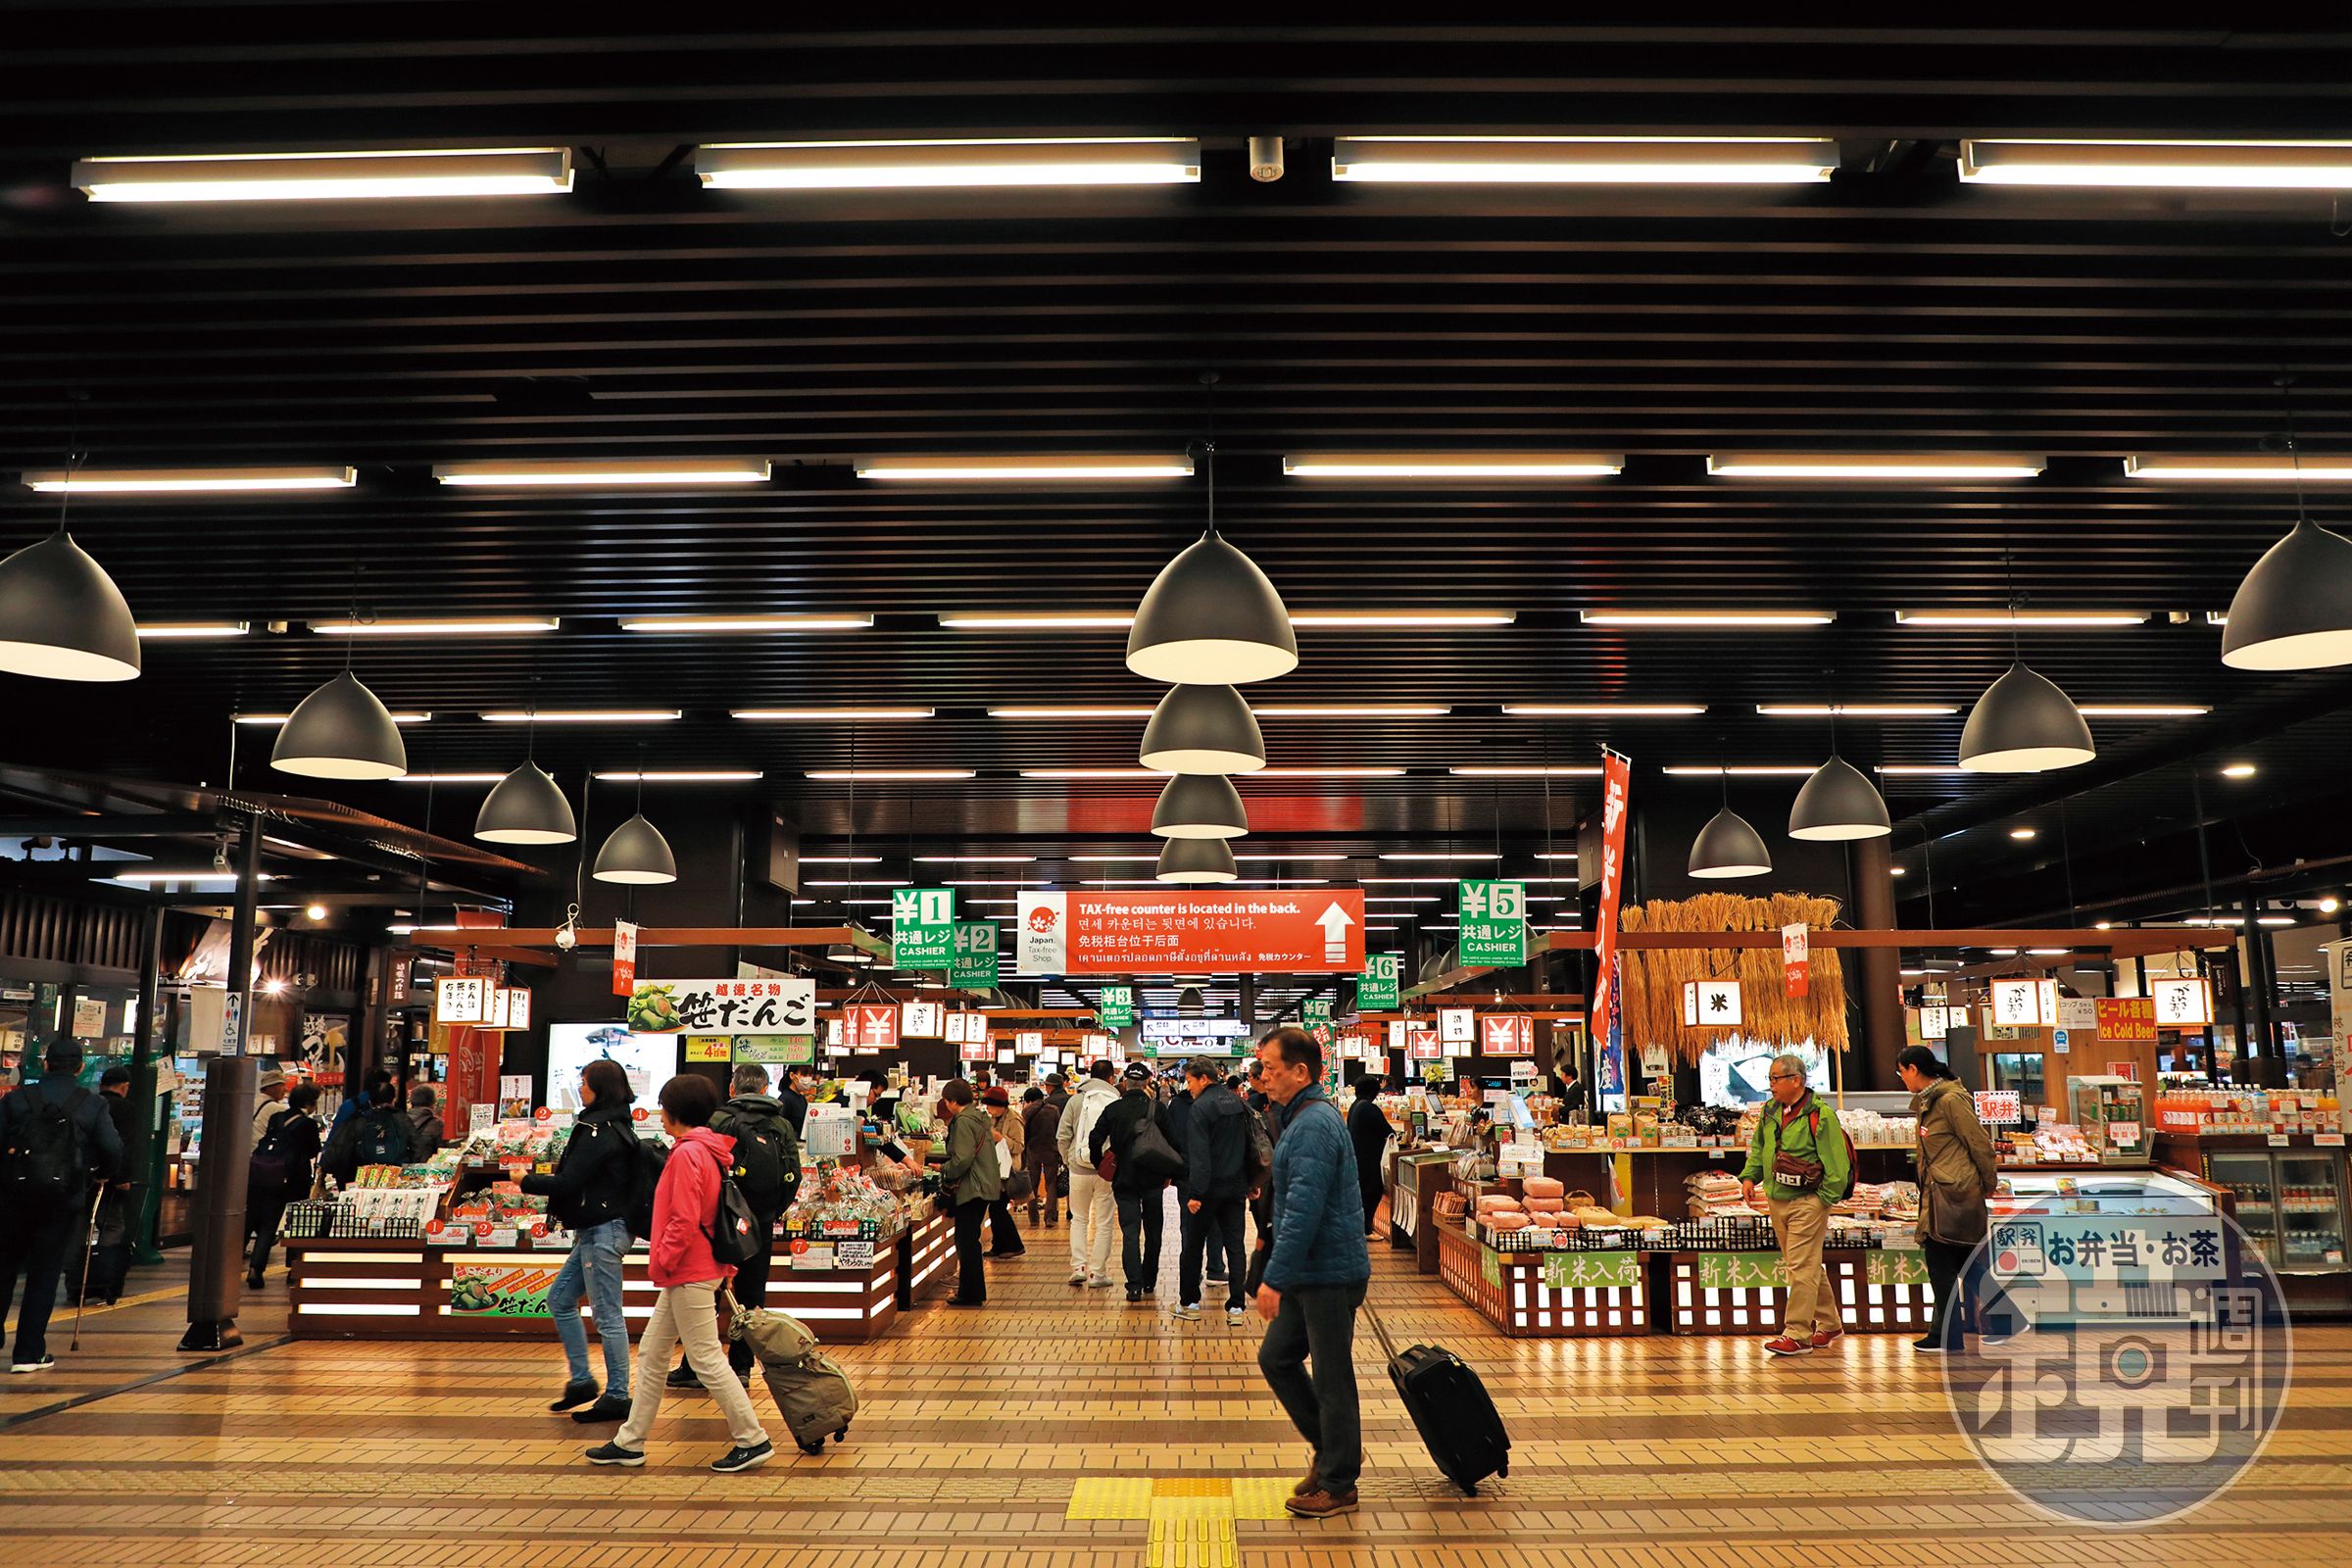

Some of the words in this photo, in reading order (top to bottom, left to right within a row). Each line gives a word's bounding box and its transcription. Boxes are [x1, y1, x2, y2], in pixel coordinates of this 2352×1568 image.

[1080, 904, 1130, 915] TAX-free
[1131, 904, 1176, 915] counter
[1178, 904, 1188, 914] is
[1190, 903, 1232, 914] located
[1235, 903, 1246, 914] in
[1248, 903, 1268, 914] the
[1269, 903, 1300, 914] back.
[1079, 917, 1102, 930] 면세
[1107, 917, 1158, 931] 카운터는
[1162, 917, 1199, 930] 뒷면에
[1203, 917, 1256, 931] 있습니다.
[1462, 924, 1521, 941] 共通レジ
[896, 931, 951, 945] 共通レジ
[1079, 935, 1179, 948] 免税柜台位于后面
[900, 947, 946, 956] CASHIER
[1467, 943, 1516, 953] CASHIER
[1033, 955, 1052, 963] Shop
[1258, 953, 1311, 961] 免税カウンター
[715, 983, 781, 997] 越後名物
[1360, 982, 1396, 993] 共通レジ
[678, 992, 811, 1029] 笹だんご
[1710, 993, 1728, 1012] 米
[2097, 1000, 2154, 1019] ビール各種
[2099, 1022, 2112, 1039] Ice
[2114, 1022, 2133, 1039] Cold
[2135, 1022, 2155, 1039] Beer
[1982, 1100, 2018, 1118] 駅弁
[1996, 1227, 2037, 1247] 駅弁
[2047, 1229, 2220, 1268] お弁当・お茶
[1545, 1257, 1637, 1287] 新米入荷
[1867, 1251, 1930, 1284] 新米入
[498, 1296, 549, 1314] 笹だん
